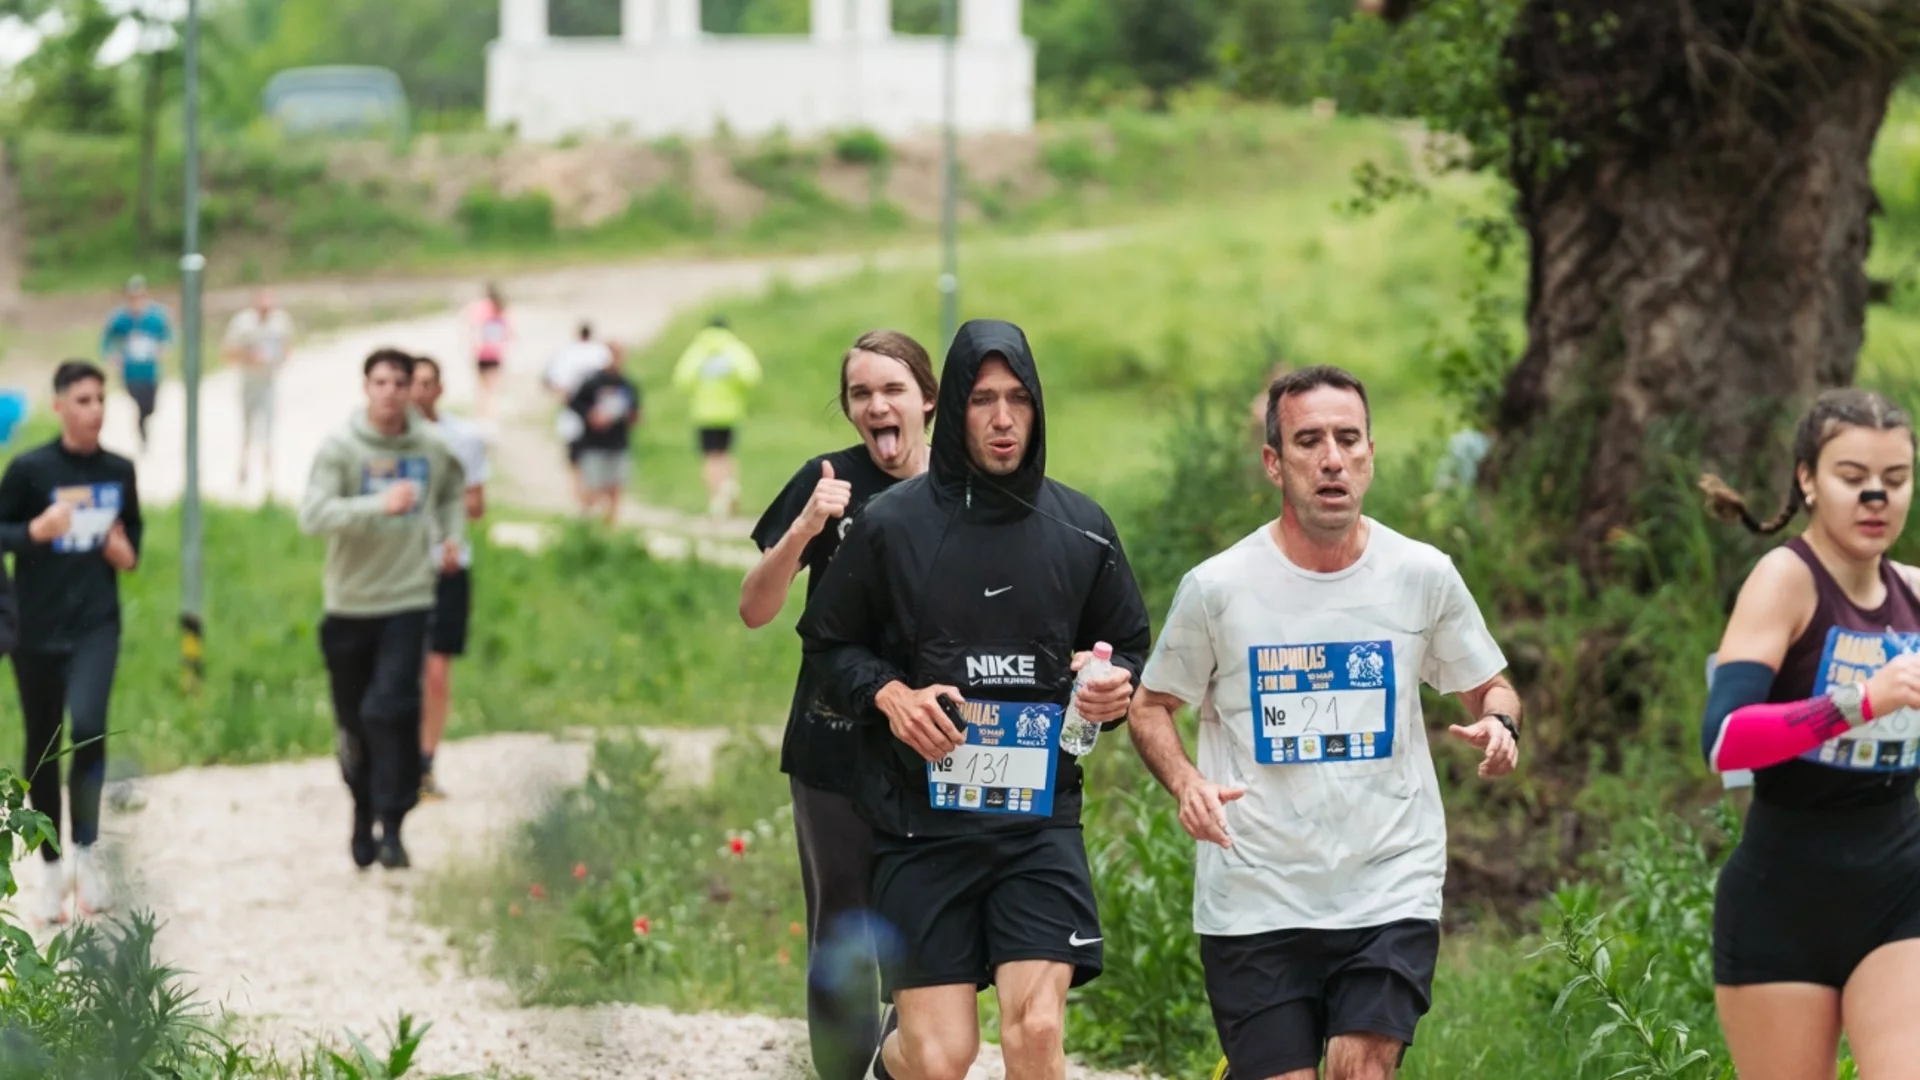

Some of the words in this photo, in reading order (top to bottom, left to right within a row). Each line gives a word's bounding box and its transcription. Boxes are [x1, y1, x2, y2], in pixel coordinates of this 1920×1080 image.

[966, 655, 1036, 678] NIKE
[982, 677, 1002, 685] NIKE
[1003, 677, 1036, 685] RUNNING
[1301, 695, 1339, 733] 21
[966, 752, 1009, 784] 131
